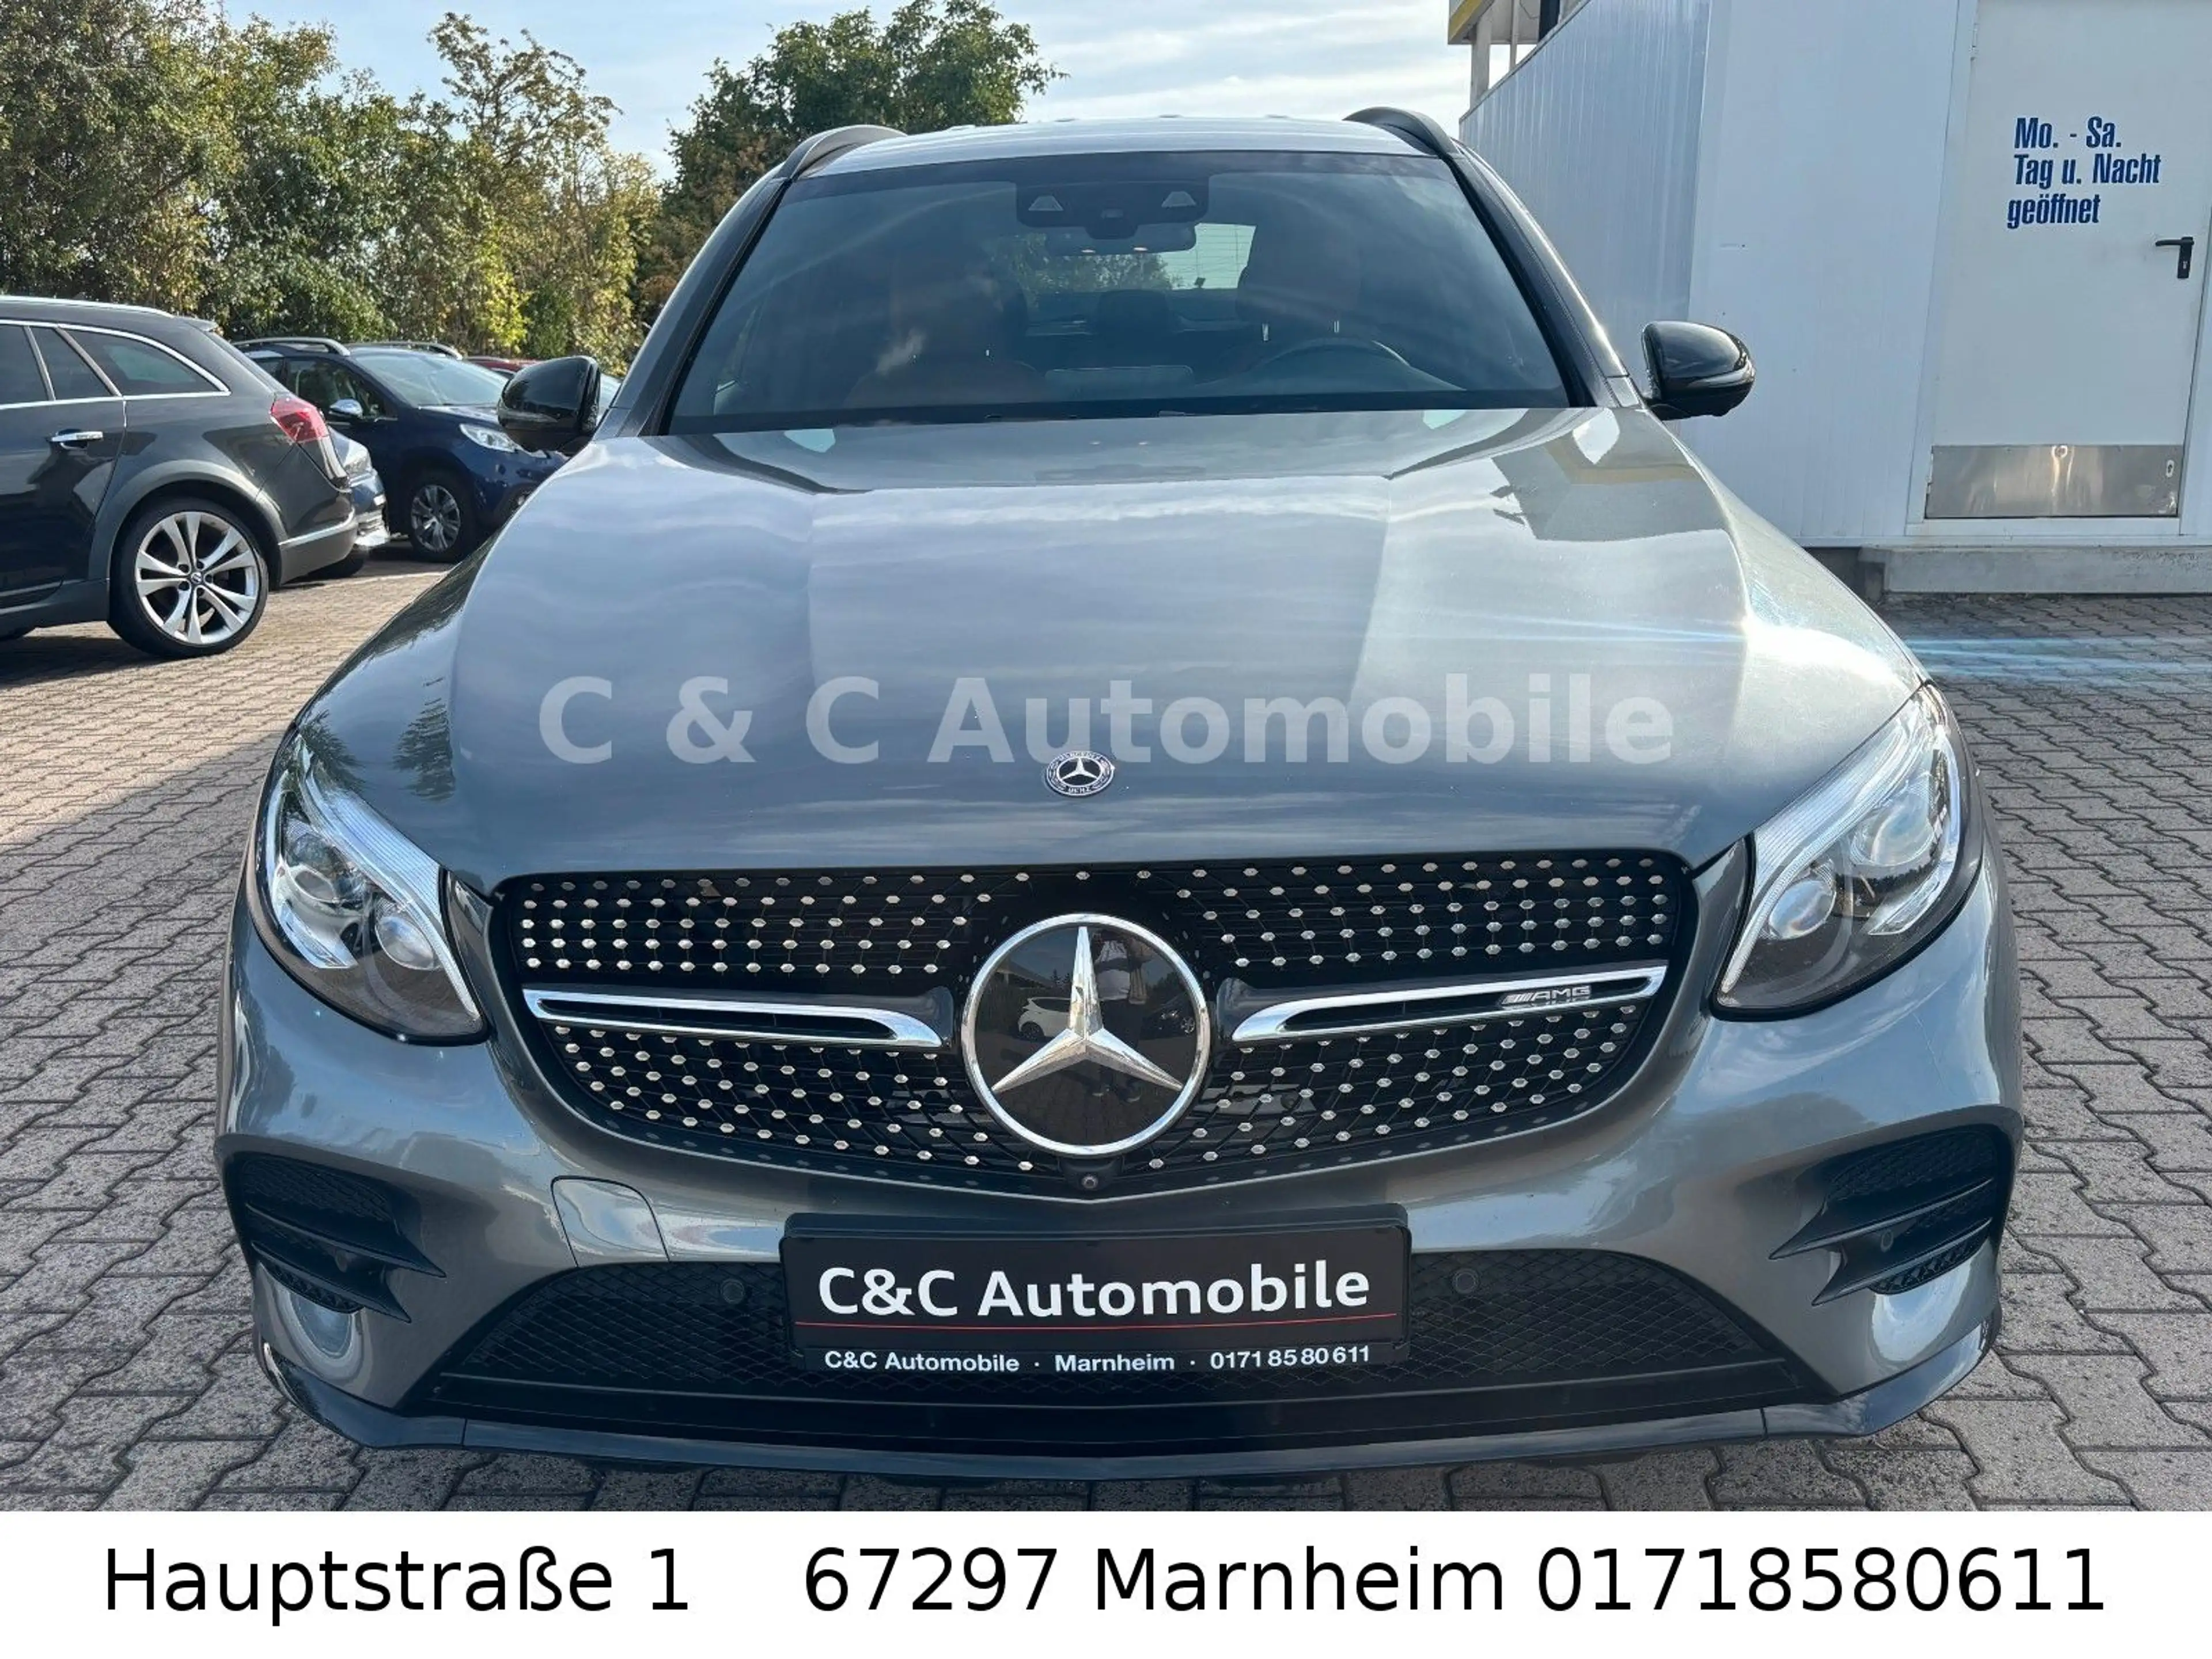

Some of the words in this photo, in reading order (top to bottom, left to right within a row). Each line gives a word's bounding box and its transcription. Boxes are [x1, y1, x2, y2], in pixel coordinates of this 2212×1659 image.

[2014, 117, 2058, 149] Mo.
[2086, 116, 2122, 148] Sa.
[2014, 154, 2054, 190] Tag
[2062, 159, 2081, 184] u.
[2092, 153, 2161, 184] Nacht
[2007, 193, 2101, 229] geöffnet
[1531, 985, 1591, 1002] AMG
[819, 1267, 957, 1317] C&C
[977, 1259, 1369, 1317] Automobile
[825, 1350, 877, 1370] C&C
[885, 1351, 1020, 1372] Automobile
[1055, 1353, 1175, 1372] Marnheim
